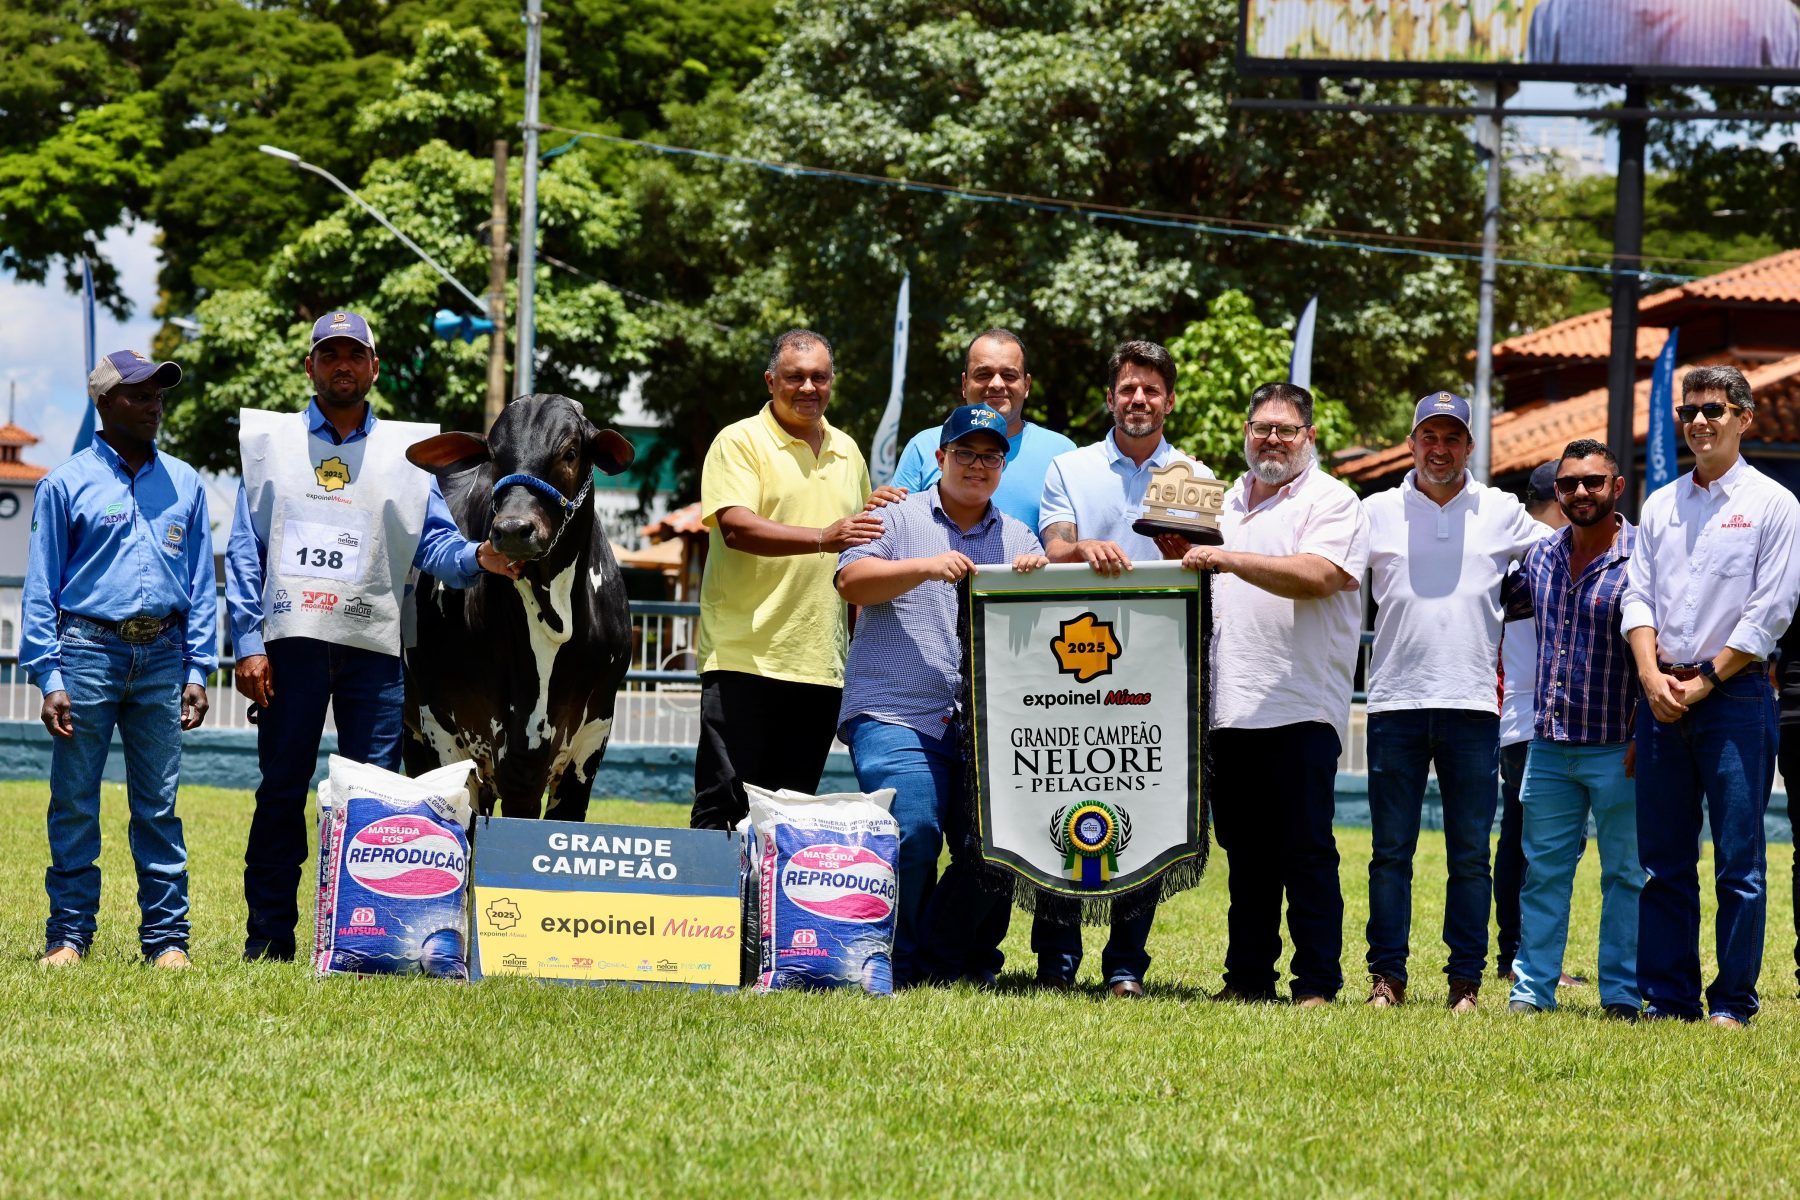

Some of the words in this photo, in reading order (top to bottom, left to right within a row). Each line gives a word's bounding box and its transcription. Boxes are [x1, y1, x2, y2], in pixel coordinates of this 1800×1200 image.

[1146, 480, 1225, 509] nelore
[338, 537, 359, 546] nelore
[297, 547, 343, 570] 138
[273, 601, 291, 610] ABCZ
[301, 603, 333, 612] PROGRAMA
[344, 603, 372, 616] nelore
[1068, 642, 1106, 654] 2025
[1023, 689, 1101, 709] expoinel
[1104, 689, 1152, 706] Minas
[1011, 727, 1080, 747] GRANDE
[1084, 721, 1162, 746] CAMPEÃO
[1012, 746, 1163, 776] NELORE
[1031, 775, 1145, 793] PELAGENS
[817, 818, 847, 827] MINERAL
[367, 826, 421, 835] MATSUDA
[548, 832, 672, 857] GRANDE
[349, 847, 464, 873] REPRODUÇÃO
[803, 851, 854, 862] MATSUDA
[532, 854, 678, 880] CAMPEÃO
[785, 870, 895, 900] REPRODUÇÃO
[762, 860, 770, 934] MATSUDA
[491, 911, 515, 919] 2025
[338, 926, 386, 936] MATSUDA
[540, 914, 655, 938] expoinel
[662, 917, 736, 940] Minas
[479, 930, 508, 938] expoinel
[780, 947, 829, 957] MATSUDA
[502, 958, 527, 966] nelore
[656, 962, 678, 970] nelore
